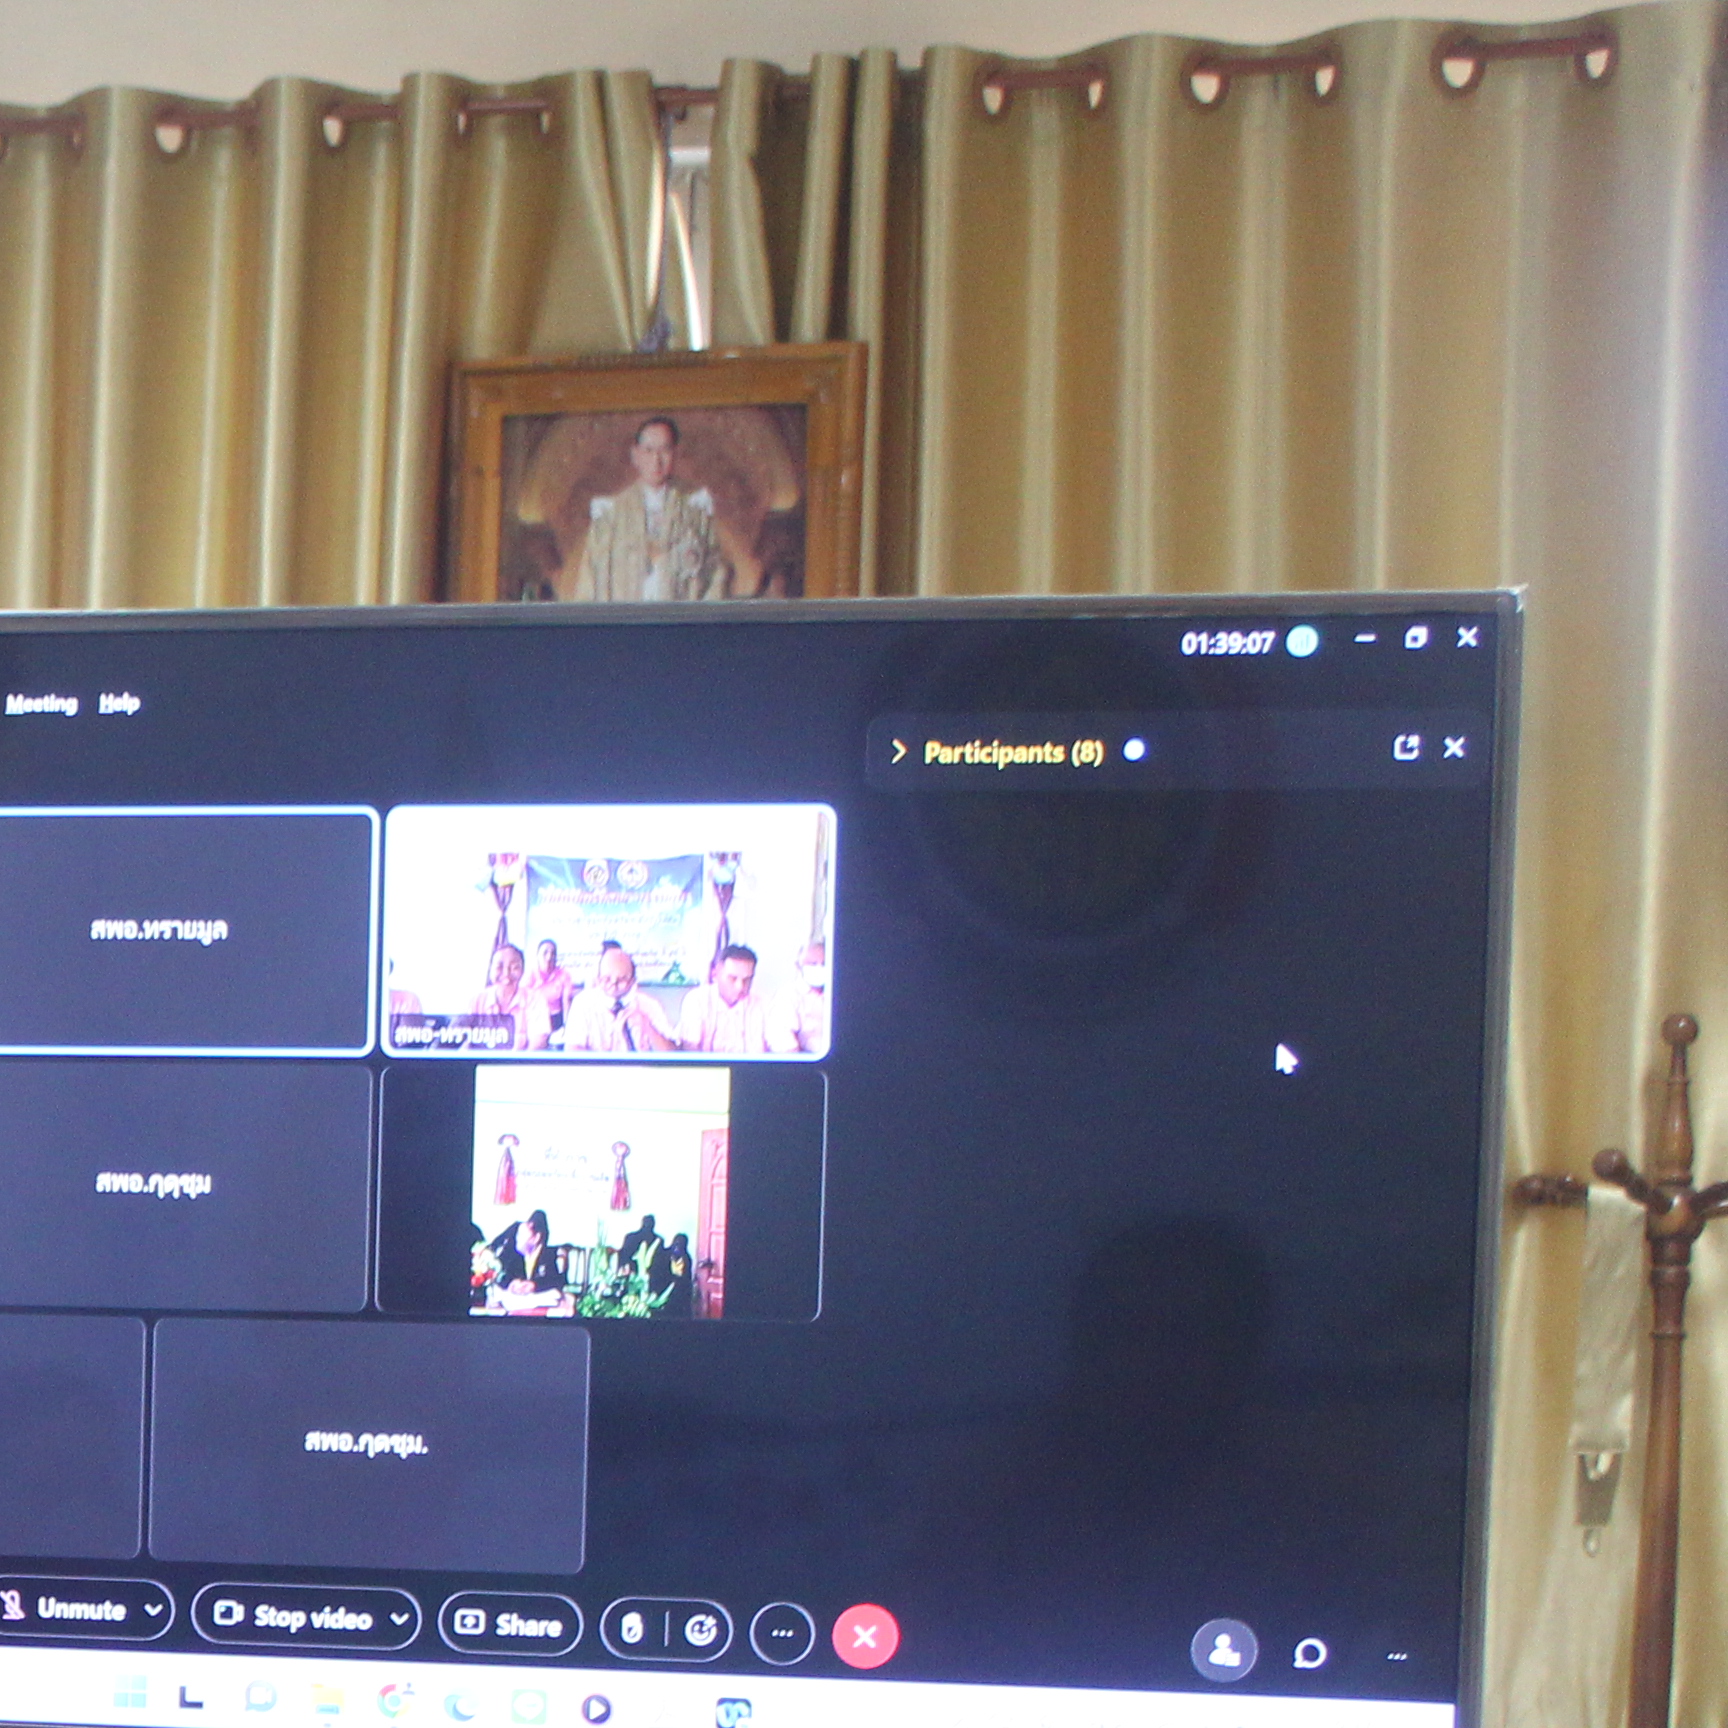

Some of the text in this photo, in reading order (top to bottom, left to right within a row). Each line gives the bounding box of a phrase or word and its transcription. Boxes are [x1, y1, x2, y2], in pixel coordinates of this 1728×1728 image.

[1181, 631, 1277, 655] 01:39:07
[5, 692, 78, 717] Meeting
[99, 691, 142, 716] Help
[924, 740, 1104, 770] Participants (8)
[90, 918, 229, 946] สพอ.ทรายมูล
[37, 1597, 127, 1622] Unmute
[254, 1604, 374, 1633] Stop video
[495, 1613, 564, 1638] Share
